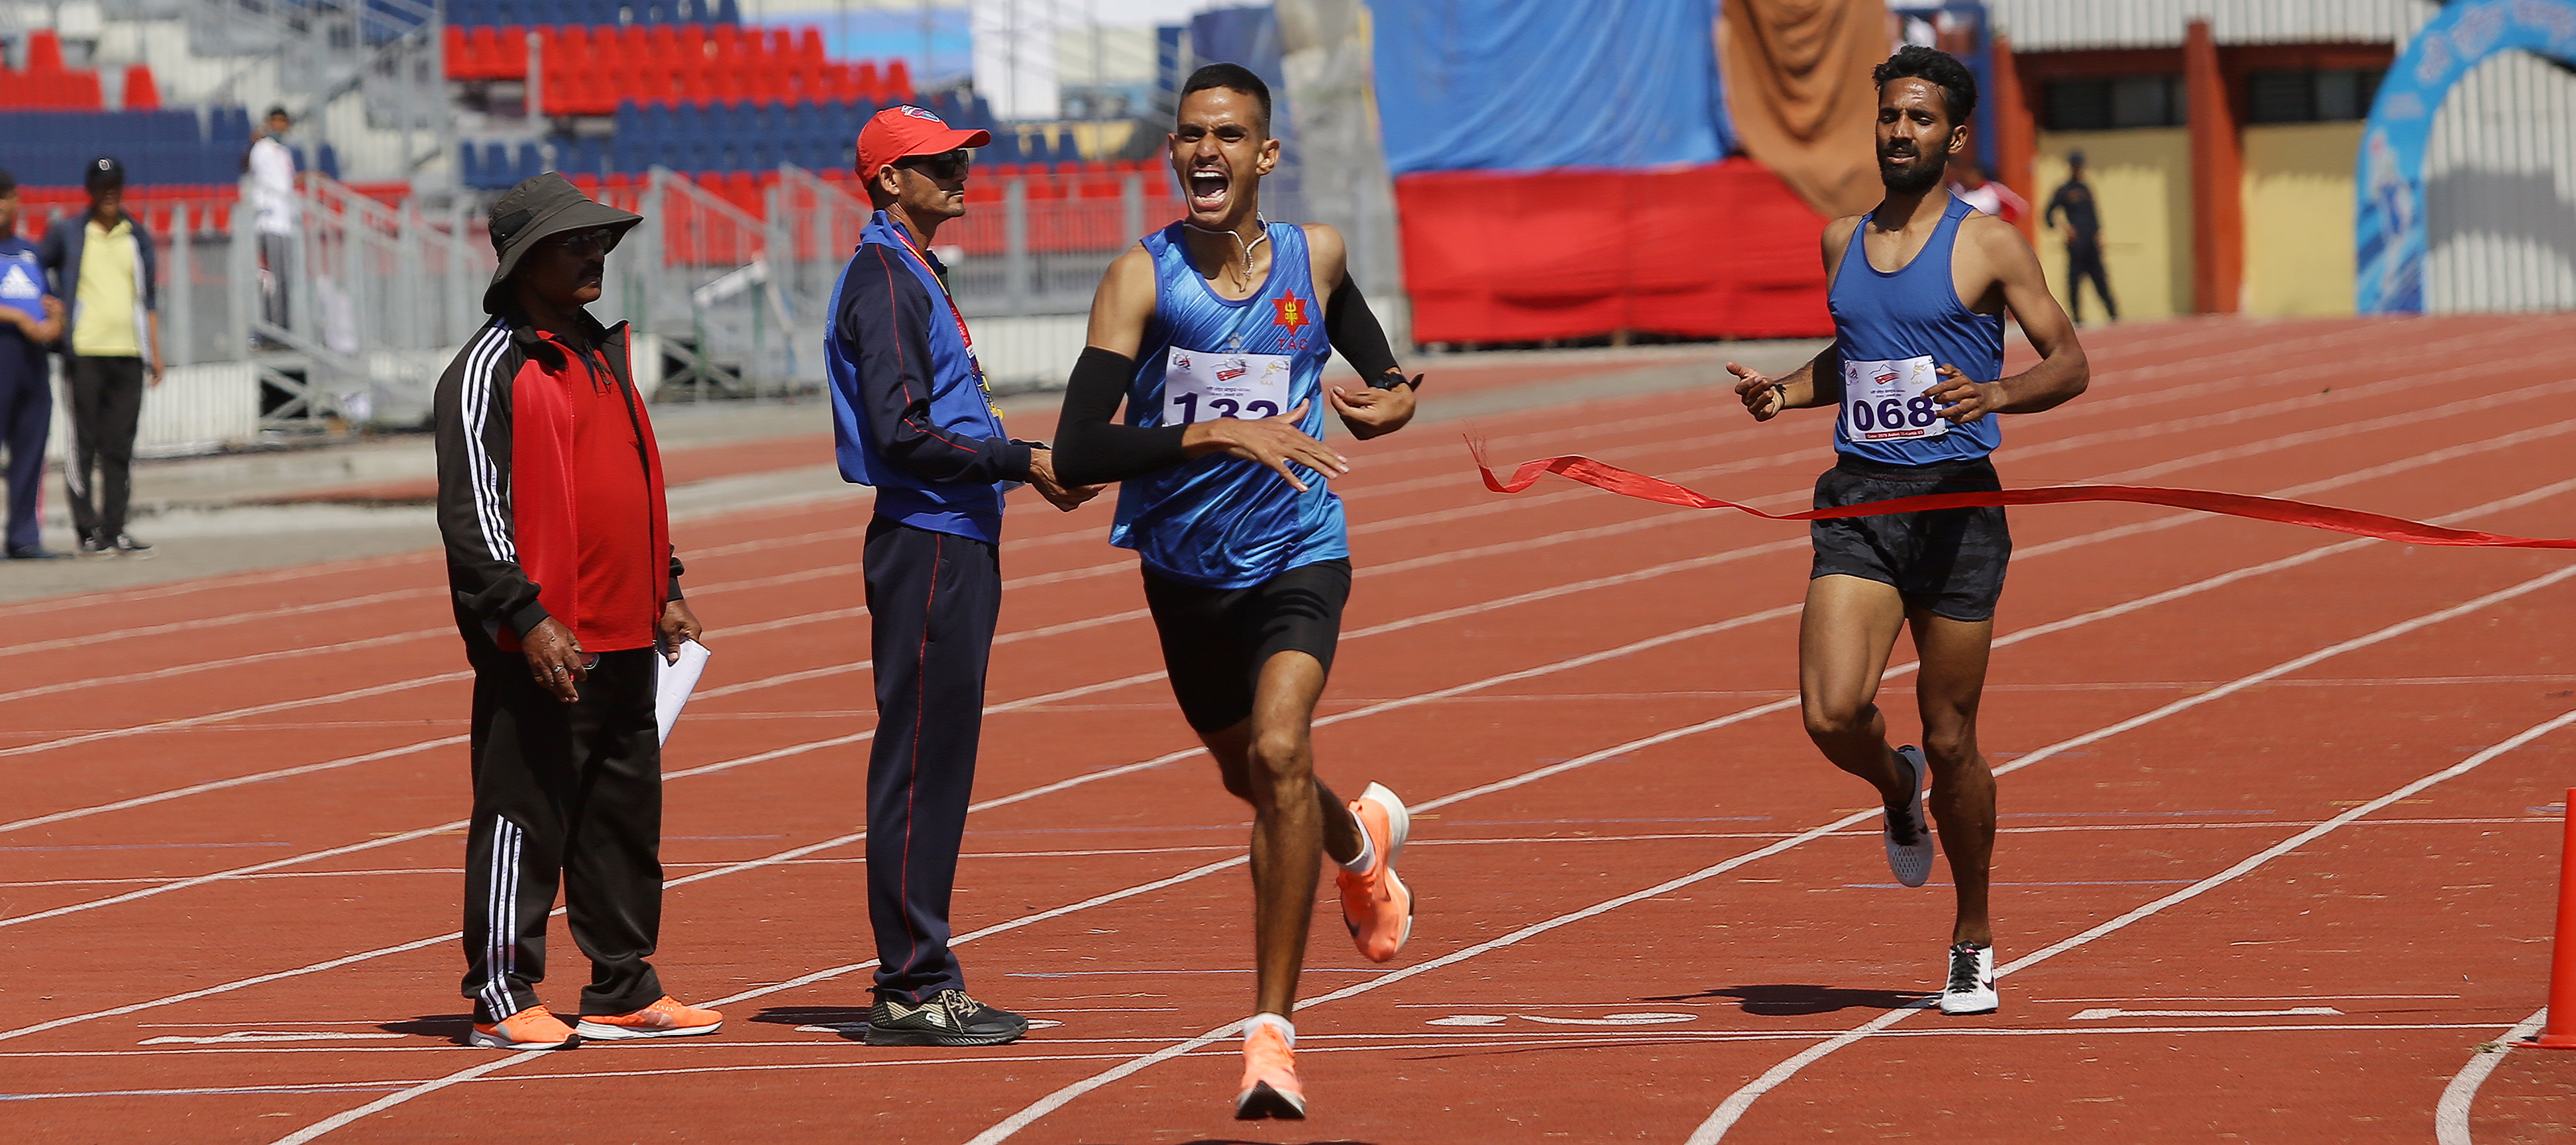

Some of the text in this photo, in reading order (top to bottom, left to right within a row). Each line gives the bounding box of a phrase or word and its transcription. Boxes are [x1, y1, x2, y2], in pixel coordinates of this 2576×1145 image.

[1277, 338, 1308, 351] TAC
[1173, 392, 1279, 423] 132
[1852, 396, 1937, 431] 068
